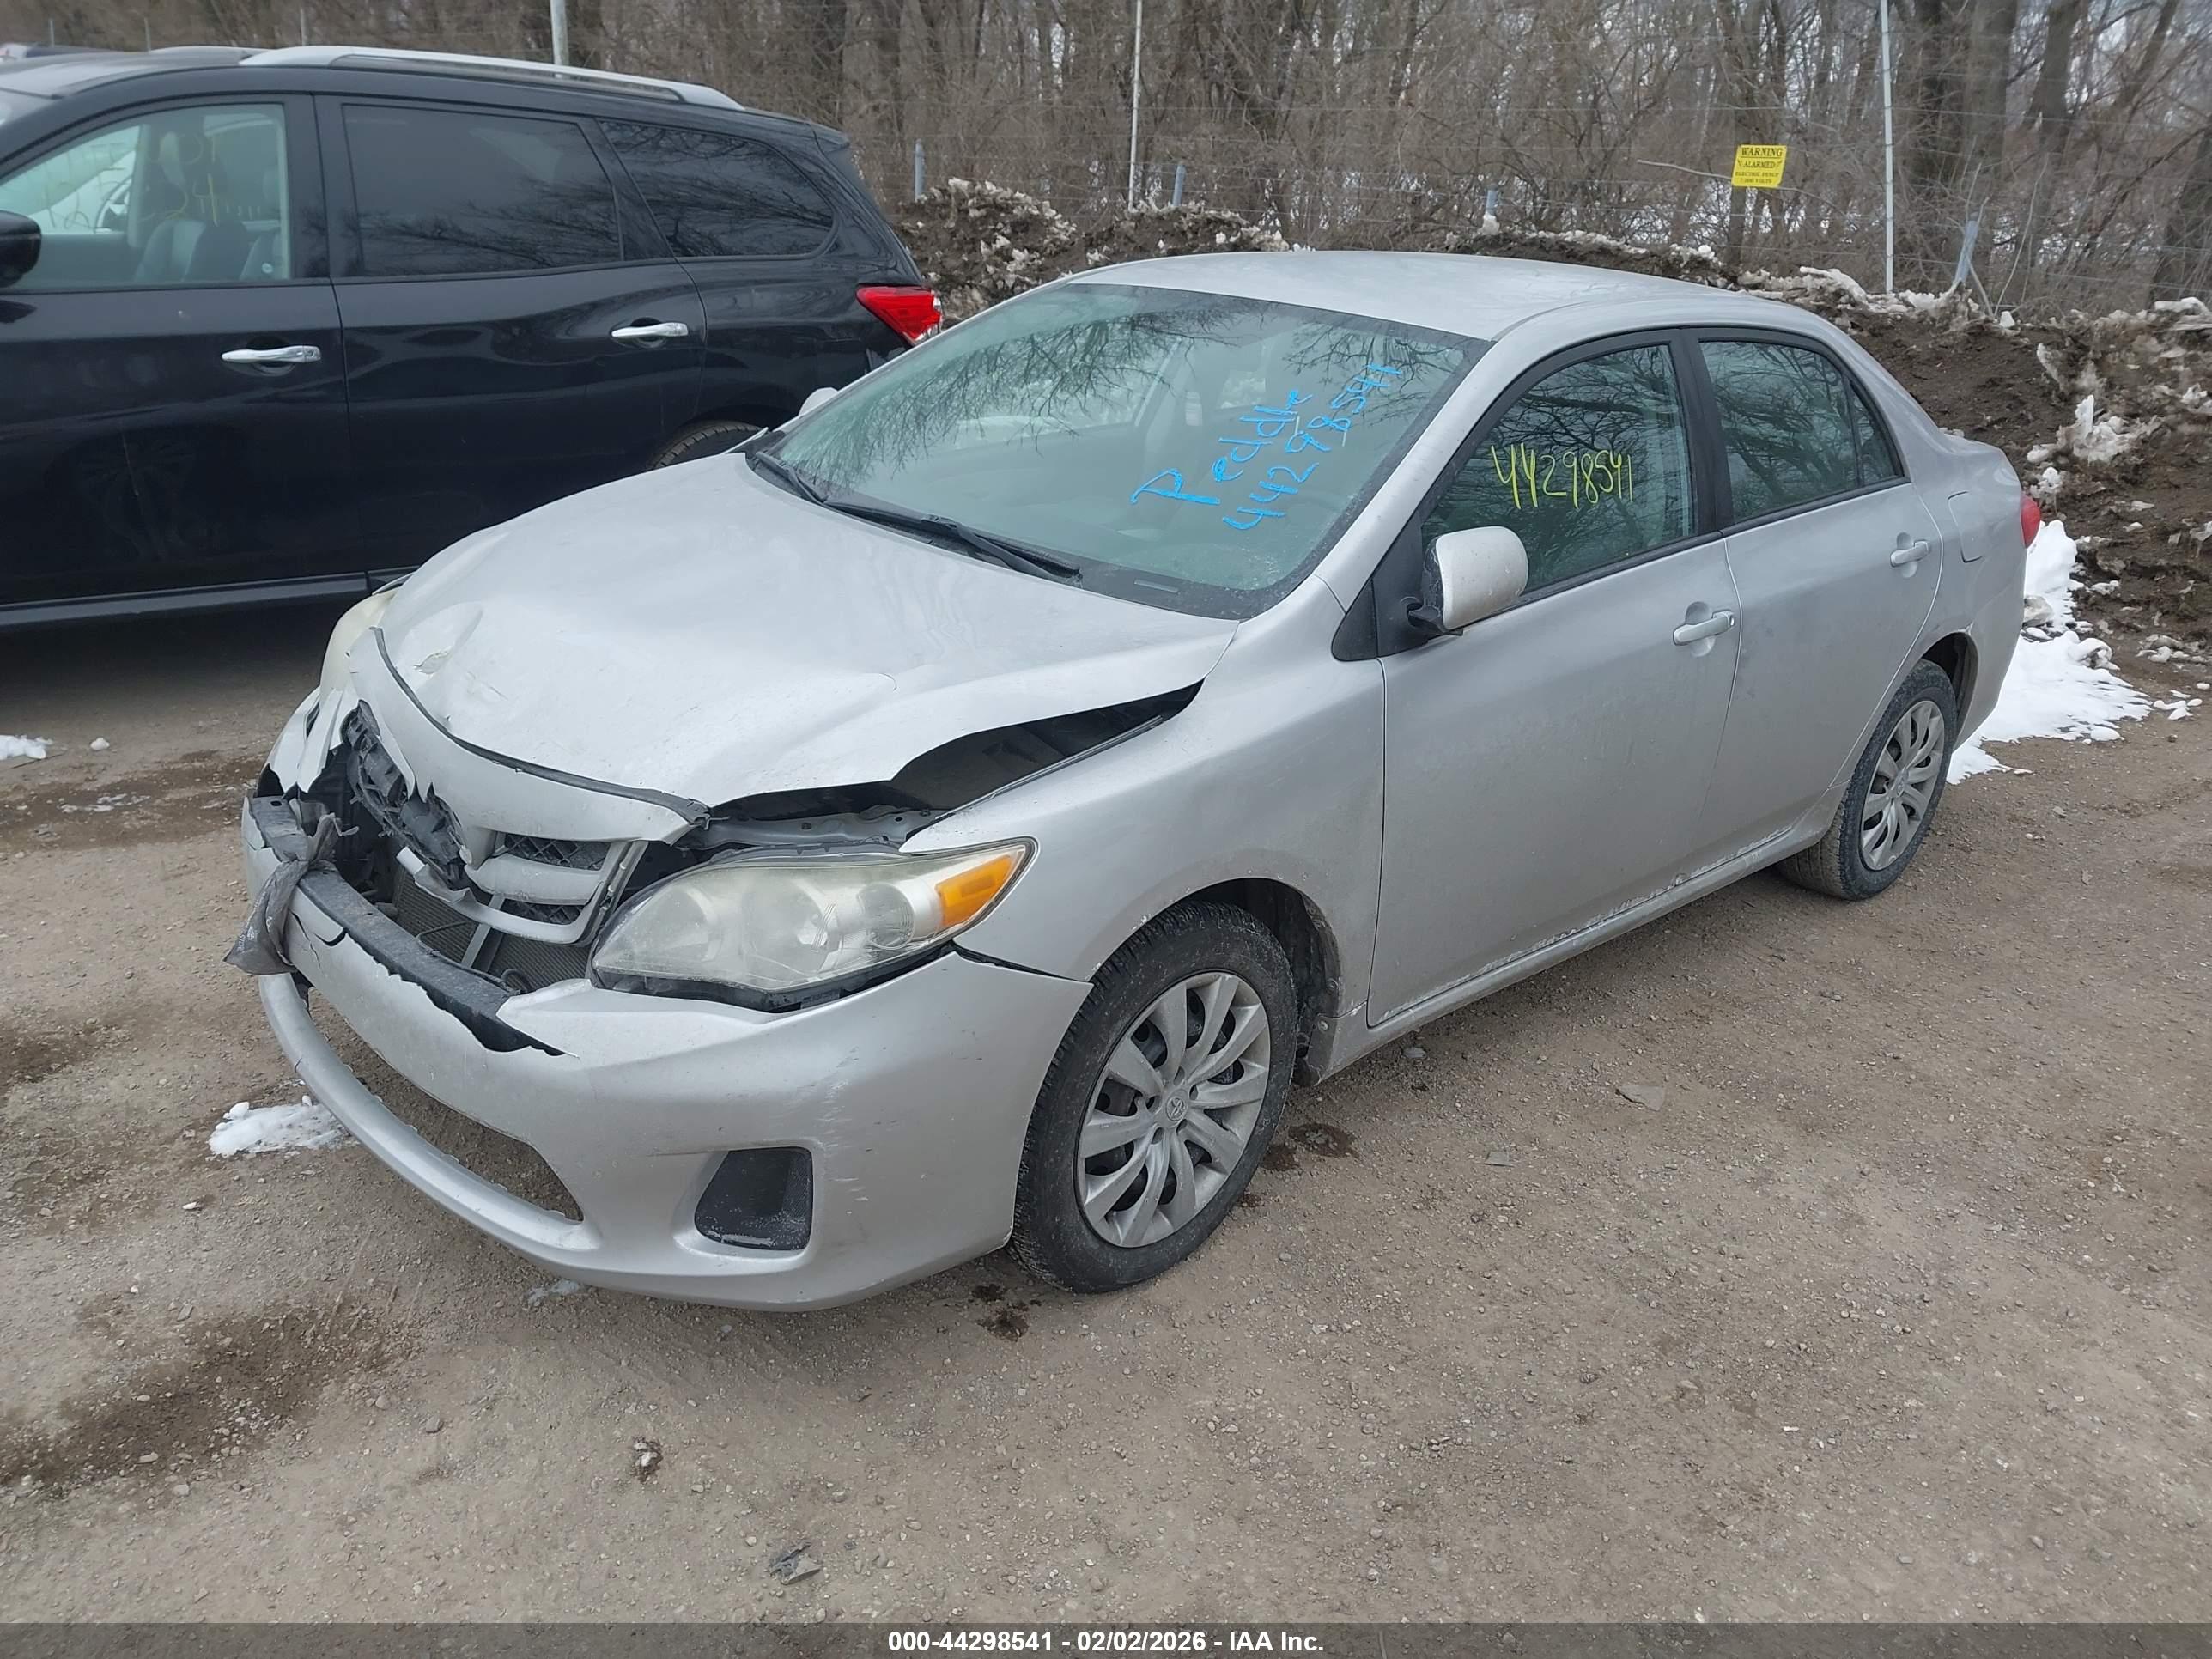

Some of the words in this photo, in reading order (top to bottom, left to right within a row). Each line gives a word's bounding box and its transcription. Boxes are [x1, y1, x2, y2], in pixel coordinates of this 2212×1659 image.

[1741, 147, 1784, 157] WARNING
[1222, 364, 1401, 530] 44298541
[1491, 442, 1633, 509] 44298541
